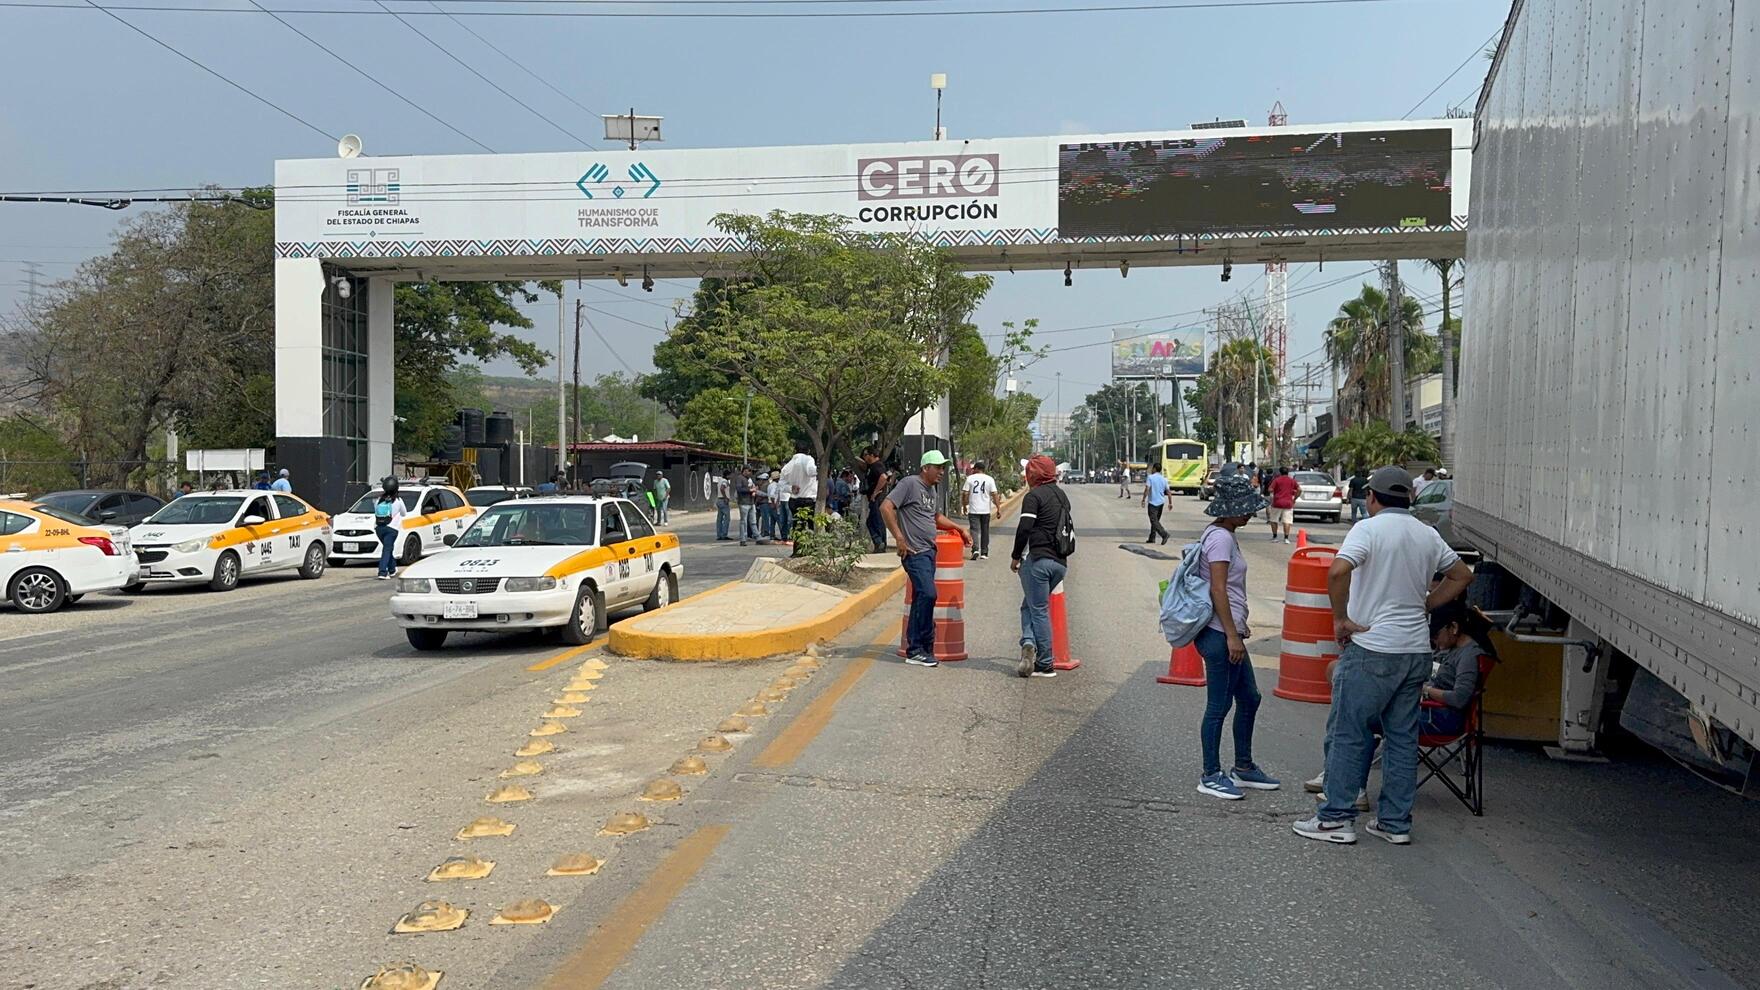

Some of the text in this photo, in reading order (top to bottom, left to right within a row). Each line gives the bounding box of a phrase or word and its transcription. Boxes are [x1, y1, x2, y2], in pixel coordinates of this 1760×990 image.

[861, 157, 995, 197] CERO
[337, 208, 371, 217] FISCALÍA
[578, 208, 659, 217] HUMANISMO QUE
[859, 199, 998, 223] CORRUPCIÓN
[386, 217, 420, 225] CHIAPAS
[577, 217, 659, 228] TRANSFORMA
[972, 480, 986, 494] 24
[288, 535, 301, 549] TAXI
[459, 559, 501, 567] 0823
